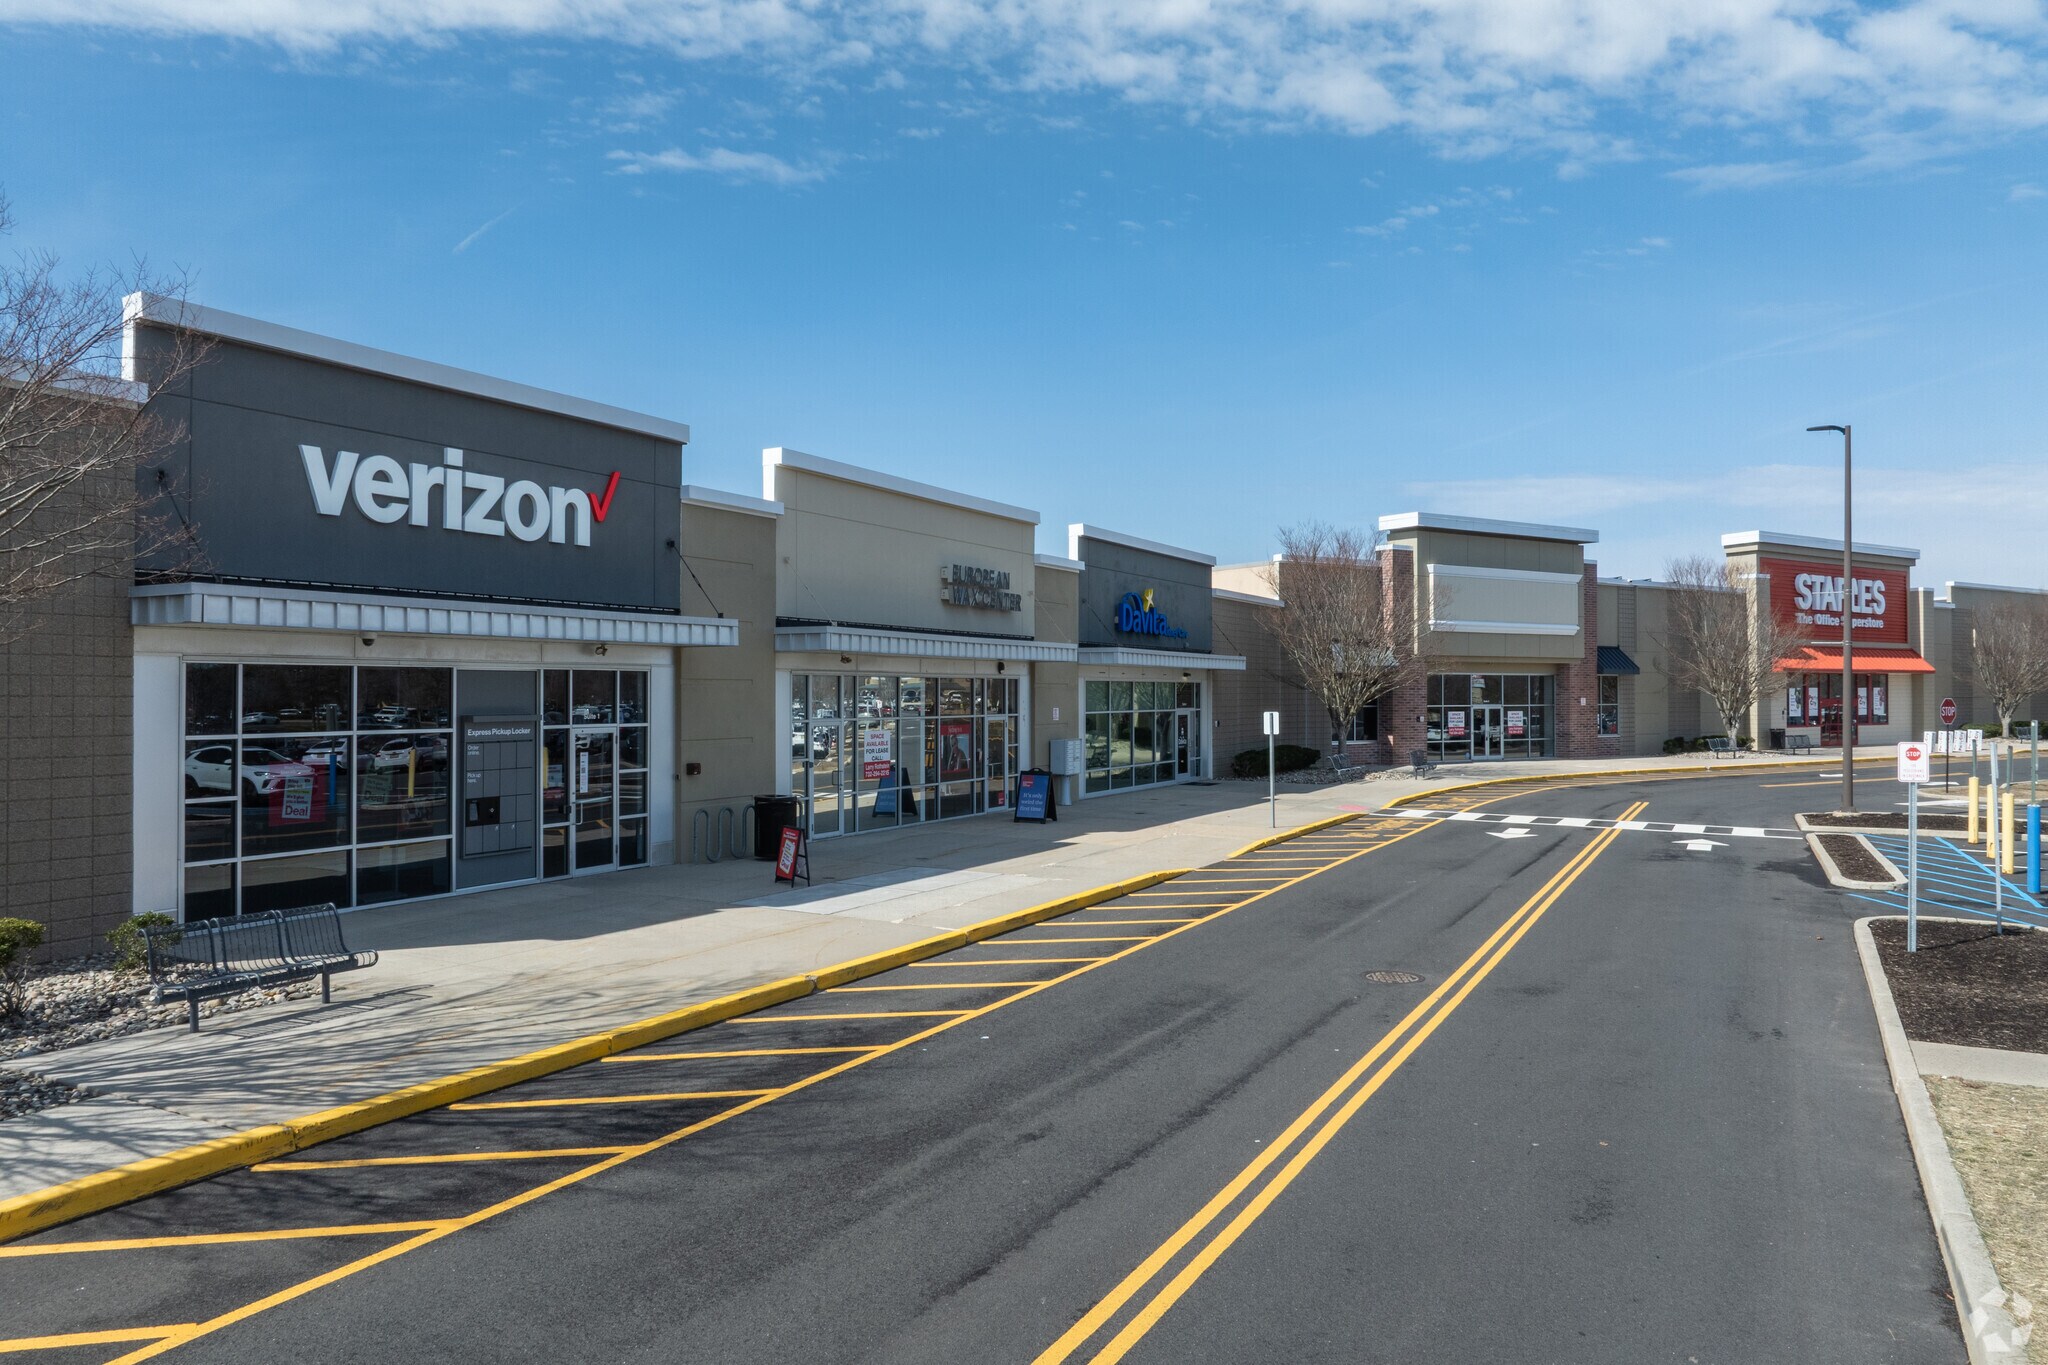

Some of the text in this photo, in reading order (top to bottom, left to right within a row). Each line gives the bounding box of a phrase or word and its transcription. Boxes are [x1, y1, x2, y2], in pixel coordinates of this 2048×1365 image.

[297, 444, 591, 547] verizon
[952, 564, 1010, 590] EUROPEAN
[952, 585, 1022, 612] WAX CENTER
[1794, 573, 1886, 615] STAPLES
[1118, 591, 1167, 636] DaVita
[1795, 612, 1813, 625] The
[1813, 613, 1840, 626] Office
[1941, 706, 1956, 716] STOP
[467, 727, 531, 737] Express Pickup Locker
[285, 804, 309, 816] Deal
